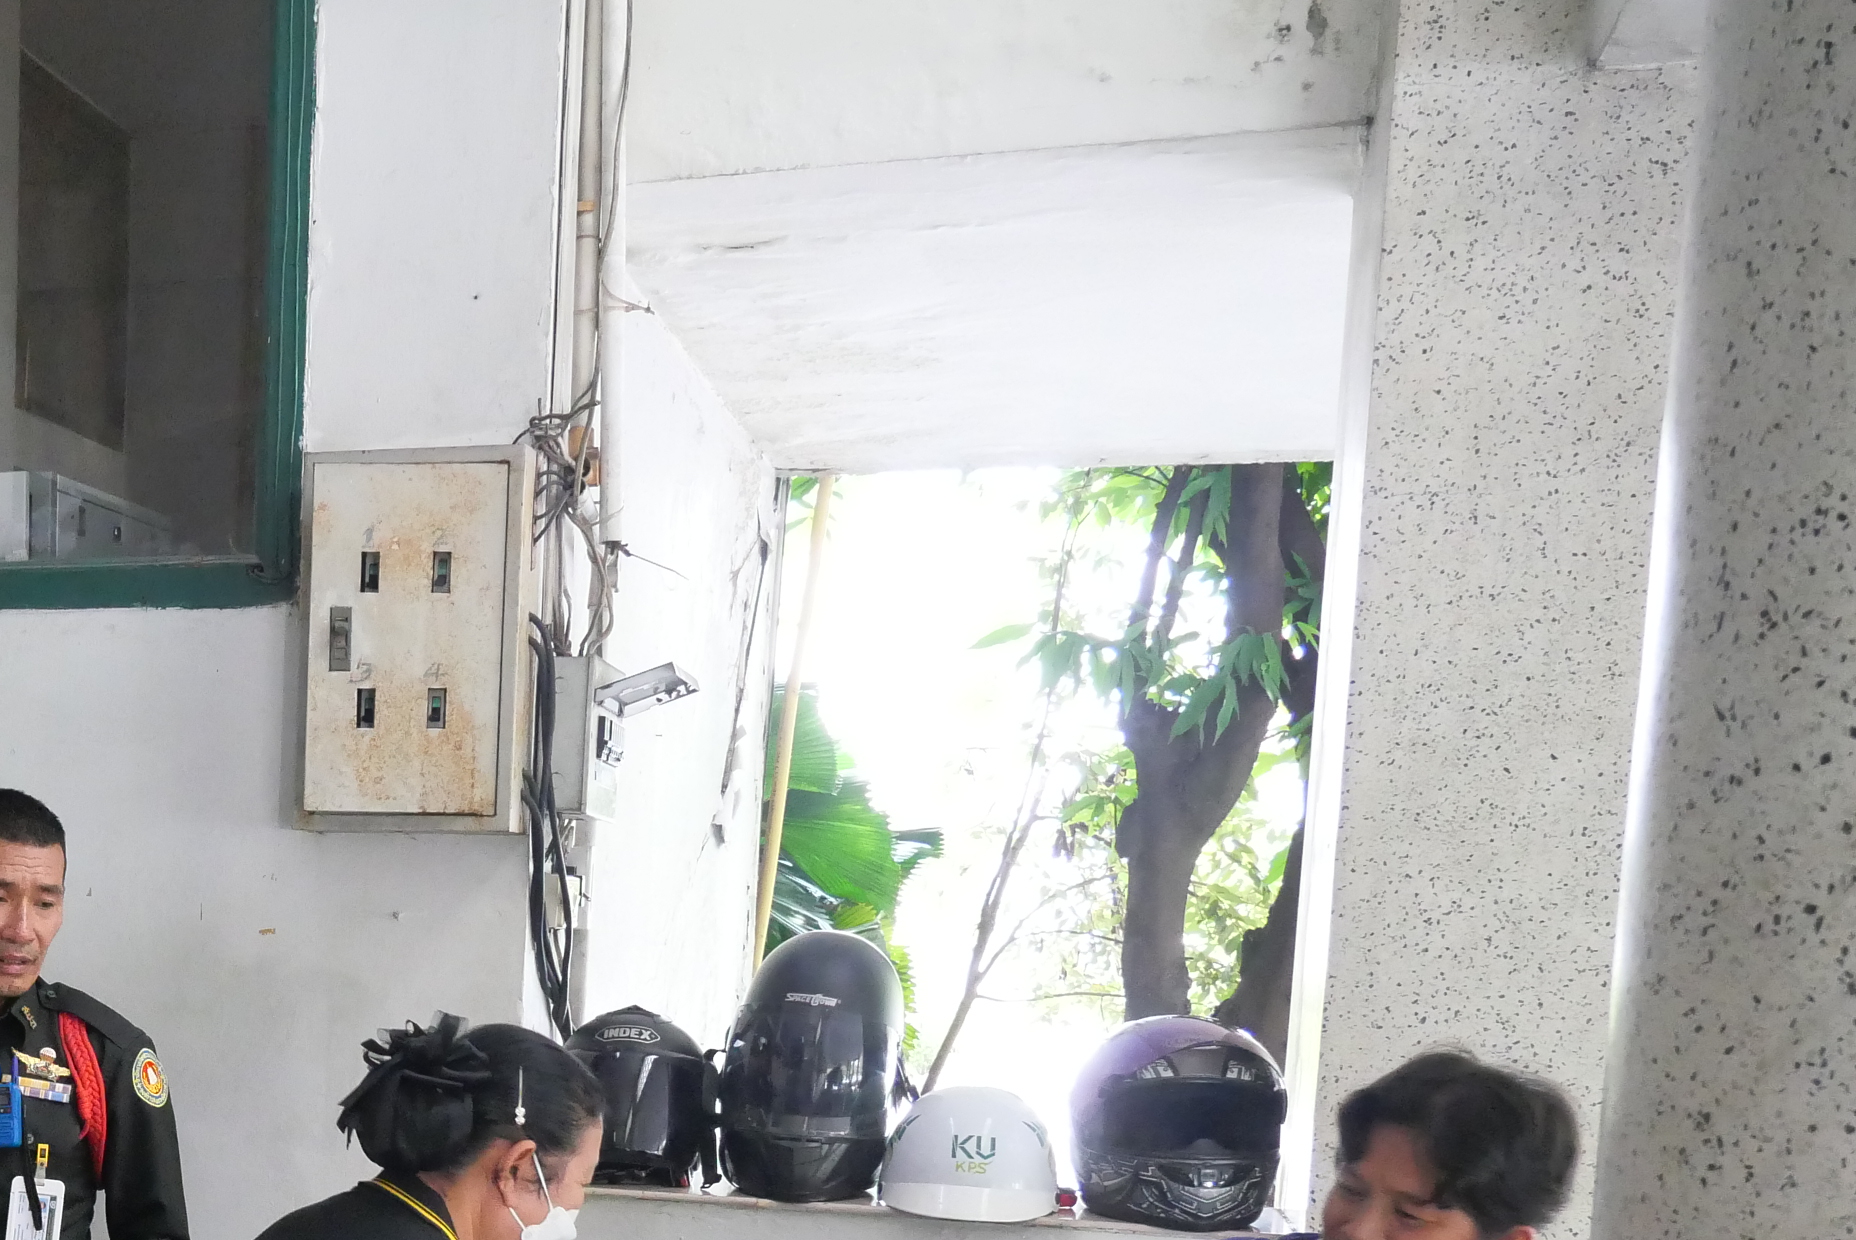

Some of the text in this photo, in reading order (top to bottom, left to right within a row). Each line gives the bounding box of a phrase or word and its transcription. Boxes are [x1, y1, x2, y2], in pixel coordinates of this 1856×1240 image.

[603, 1027, 652, 1041] INDEX
[950, 1134, 997, 1161] KU
[955, 1160, 993, 1174] KPS
